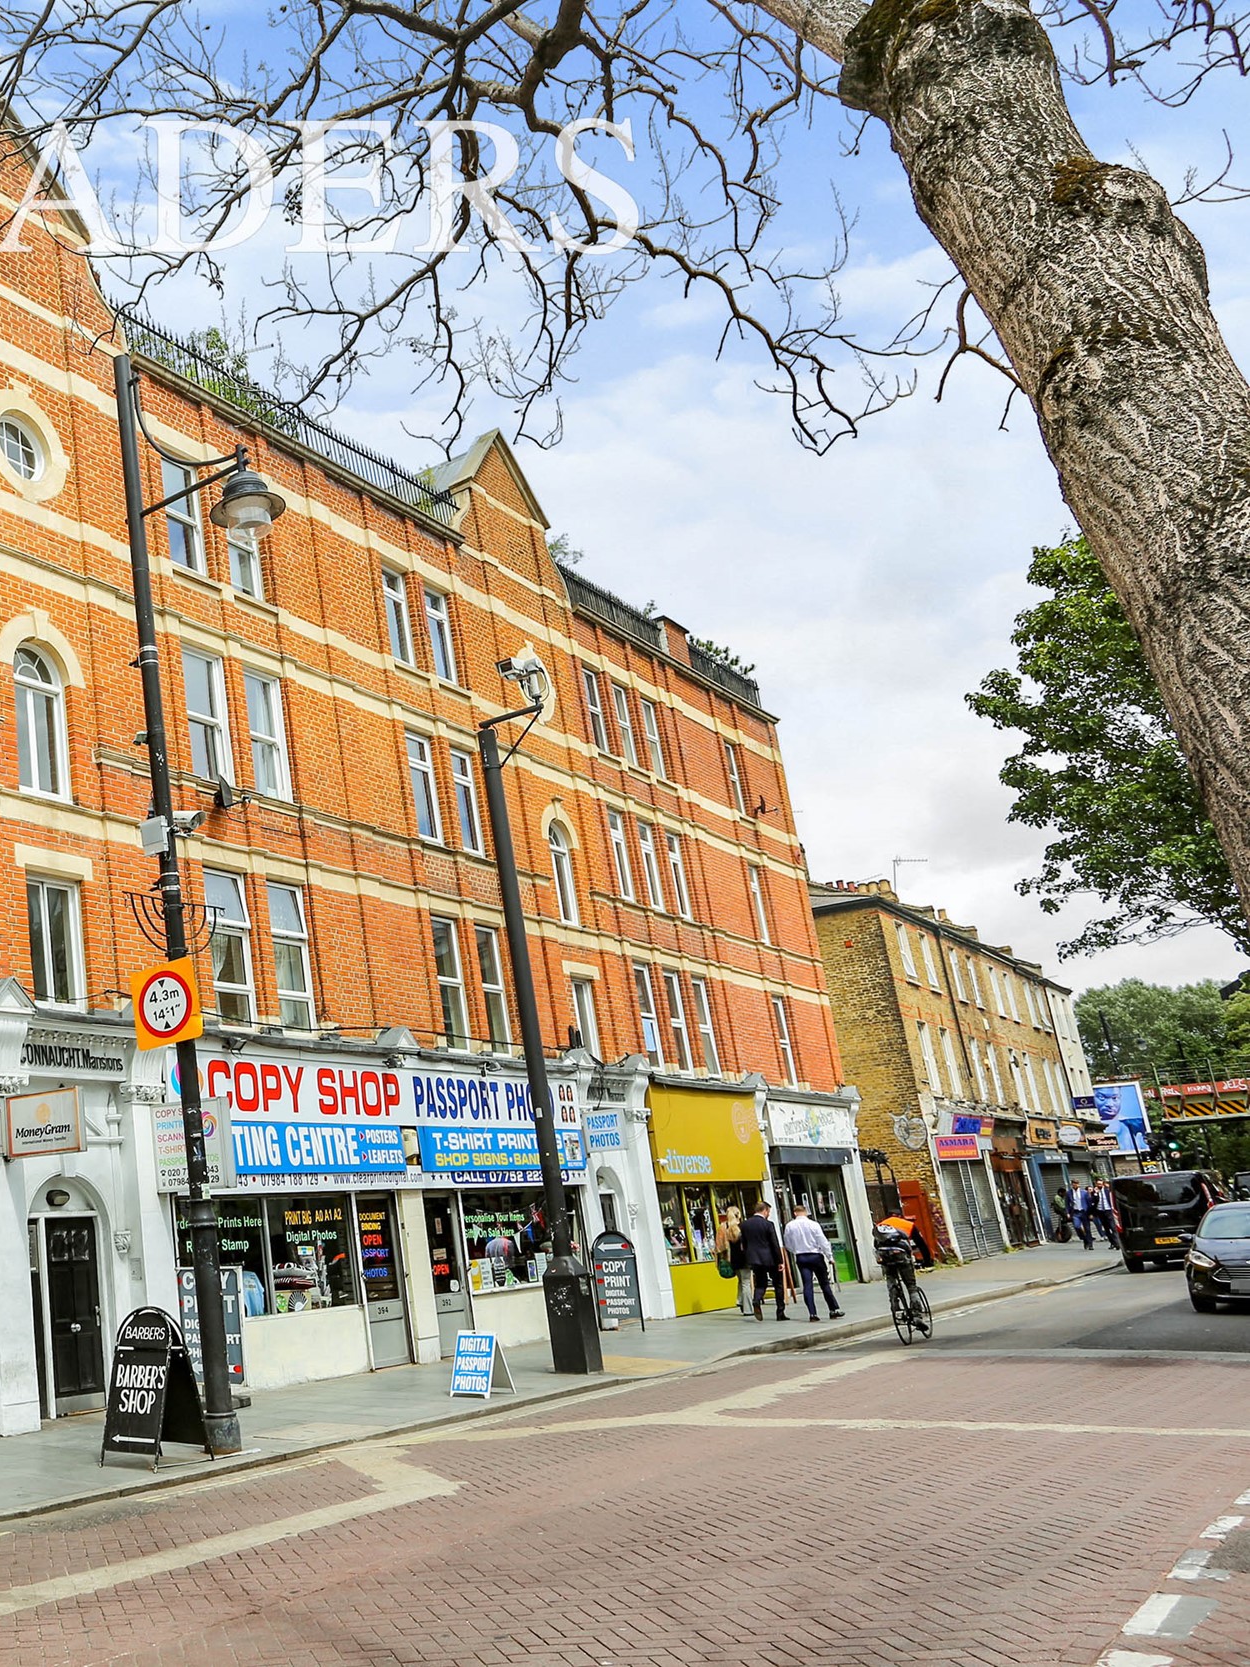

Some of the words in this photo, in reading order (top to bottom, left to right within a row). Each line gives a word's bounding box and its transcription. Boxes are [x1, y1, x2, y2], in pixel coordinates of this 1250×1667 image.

[149, 989, 180, 1004] 4.3m
[207, 1059, 304, 1113] COPY
[317, 1067, 401, 1117] SHOP
[412, 1076, 500, 1120] PASSPORT
[155, 1108, 176, 1119] COPY
[586, 1114, 618, 1130] PASSPORT
[15, 1123, 71, 1139] MoneyGram
[365, 1129, 399, 1145] POSTERS
[285, 1125, 361, 1167] CENTRE
[432, 1132, 493, 1150] T-SHIRT
[589, 1132, 621, 1148] PHOTOS
[368, 1149, 404, 1165] LEAFLETS
[435, 1152, 469, 1167] SHOP
[472, 1152, 509, 1166] SIGNS
[665, 1148, 712, 1174] diverse
[167, 1168, 181, 1177] 020
[455, 1171, 486, 1183] CALL:
[489, 1171, 524, 1183] 07752
[217, 1216, 242, 1229] Prints
[243, 1215, 262, 1227] Here
[284, 1211, 302, 1225] PRINT
[302, 1210, 312, 1225] BIG
[333, 1208, 343, 1220] A2
[358, 1211, 386, 1221] DOCUMENT
[495, 1211, 509, 1222] Your
[286, 1230, 311, 1245] Digital
[311, 1229, 337, 1241] Photos
[362, 1234, 382, 1246] OPEN
[488, 1227, 501, 1238] Sale
[501, 1227, 515, 1237] Here
[221, 1238, 249, 1253] Stamp
[433, 1263, 450, 1276] OPEN
[602, 1260, 627, 1273] COPY
[603, 1275, 631, 1288] PRINT
[605, 1289, 627, 1297] DIGITAL
[606, 1298, 636, 1306] PASSPORT
[607, 1307, 630, 1315] PHOTOS
[125, 1326, 166, 1340] BARBERS
[459, 1337, 491, 1352] DIGITAL
[456, 1356, 491, 1371] PASSPORT
[115, 1363, 167, 1389] BARBER'S
[453, 1375, 488, 1391] PHOTOS
[118, 1389, 156, 1415] SHOP
